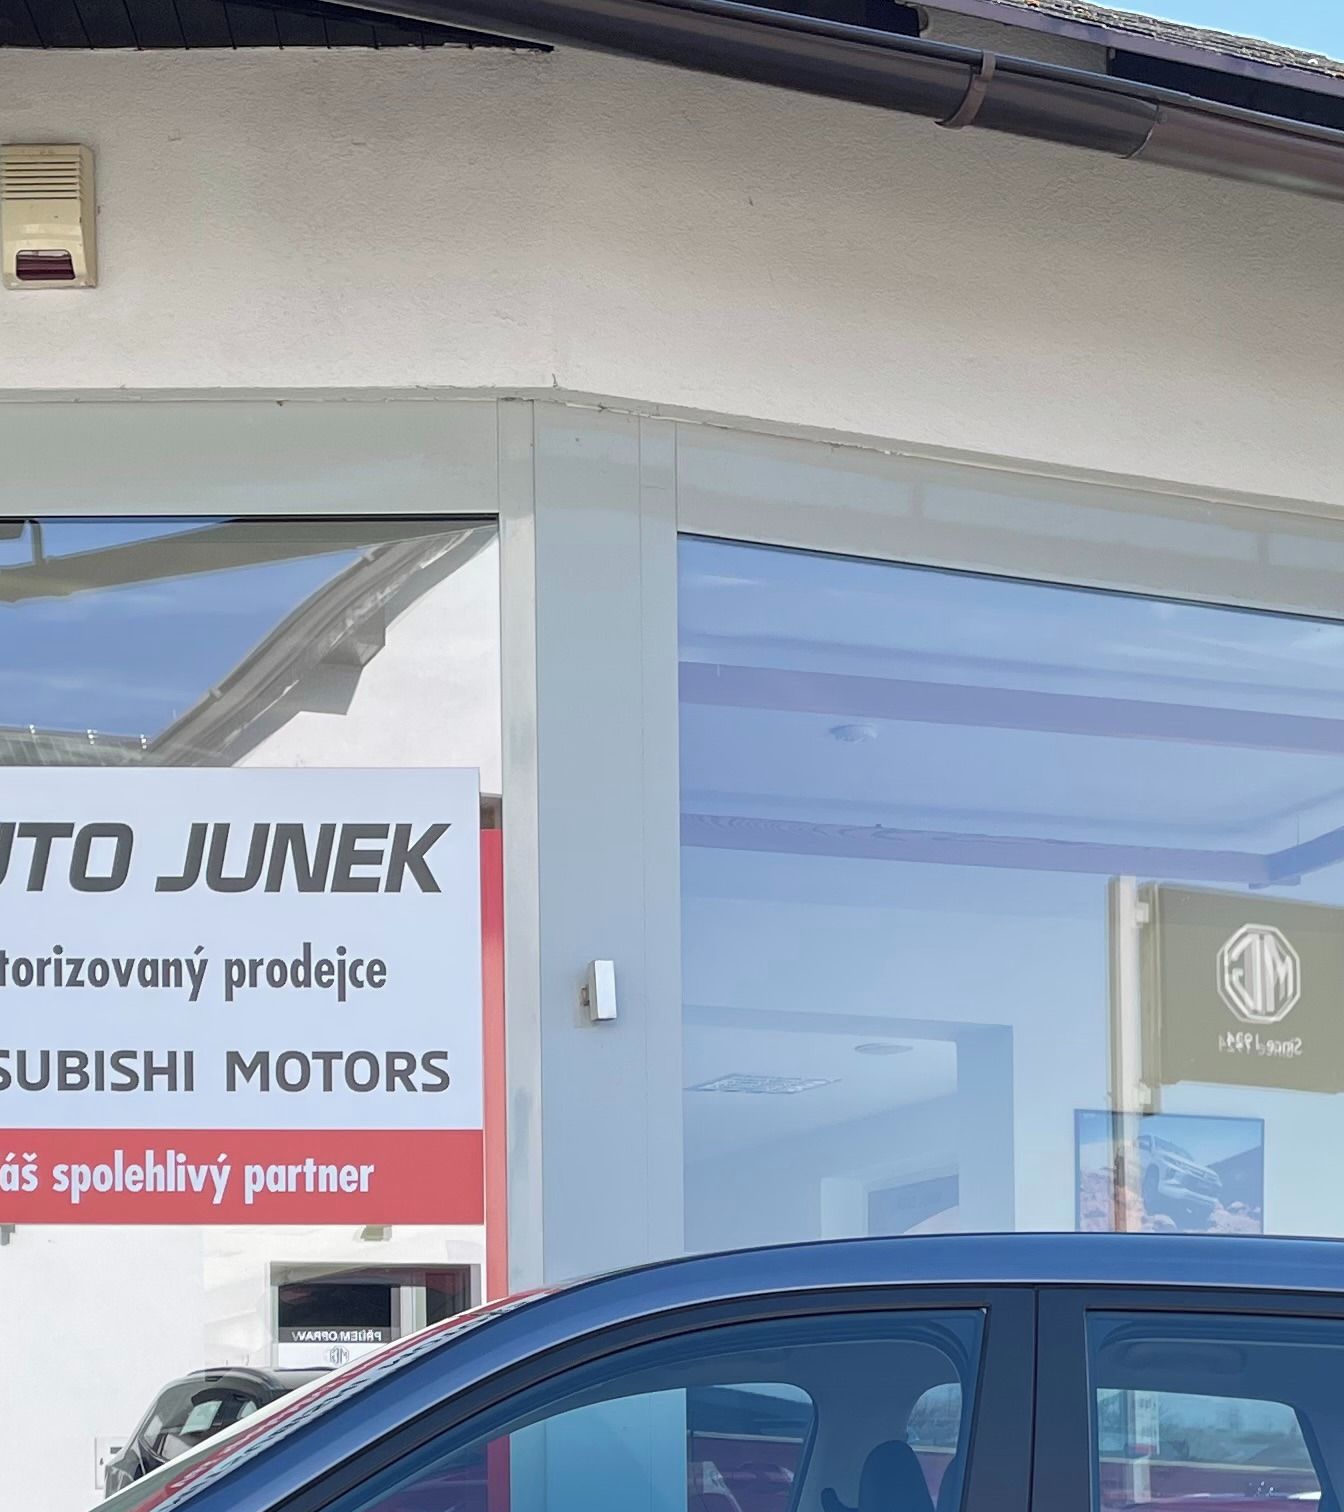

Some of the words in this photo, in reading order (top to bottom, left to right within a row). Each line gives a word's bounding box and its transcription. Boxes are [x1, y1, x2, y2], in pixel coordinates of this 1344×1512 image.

[154, 822, 452, 894] JUNEK
[224, 941, 387, 1003] prodejce
[225, 1050, 451, 1093] MOTORS
[52, 1149, 232, 1204] spolehlivý
[243, 1157, 376, 1204] partner
